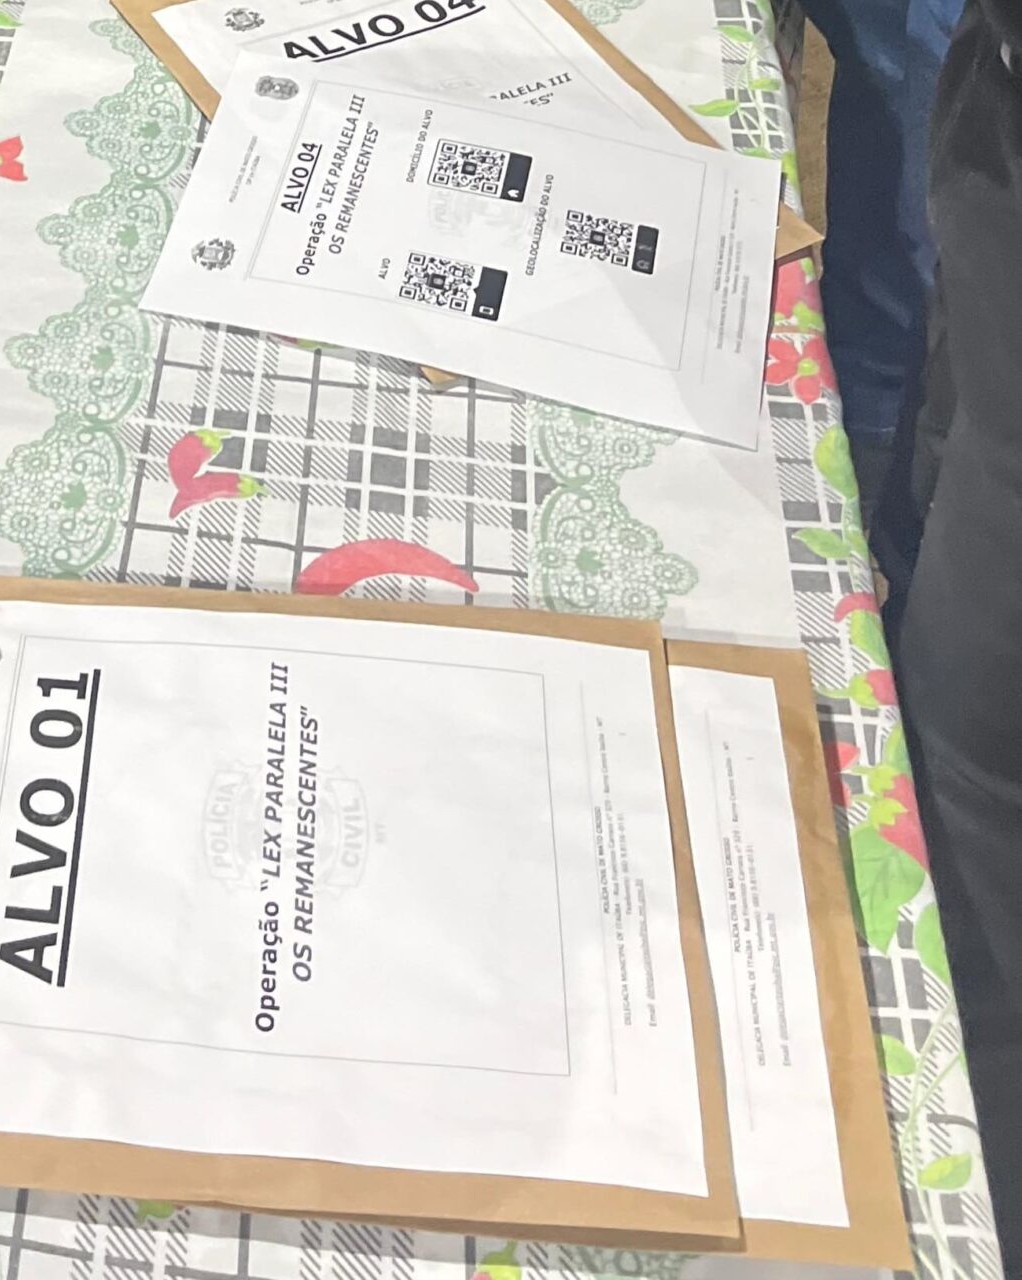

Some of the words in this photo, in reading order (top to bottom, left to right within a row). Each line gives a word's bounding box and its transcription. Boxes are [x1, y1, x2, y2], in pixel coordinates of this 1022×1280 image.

[283, 14, 405, 59] ALVO
[548, 72, 572, 87] III
[406, 141, 424, 183] DOMICÍLIO
[417, 130, 428, 142] DO
[424, 109, 434, 130] ALVO
[281, 166, 310, 213] ALVO
[297, 142, 319, 163] 04
[296, 212, 327, 275] Operação
[328, 117, 360, 178] PARALELA
[349, 94, 366, 115] III
[540, 194, 550, 206] DO
[543, 174, 554, 194] ALVO
[328, 235, 345, 255] OS
[378, 257, 391, 280] ALVO
[525, 206, 547, 276] GEOLOCALIZAÇÃO
[269, 662, 288, 695] III
[28, 670, 88, 749] 01
[264, 700, 287, 823] PARALELA
[338, 797, 364, 868] CIVIL
[254, 900, 283, 1032] Operação
[291, 942, 312, 982] OS
